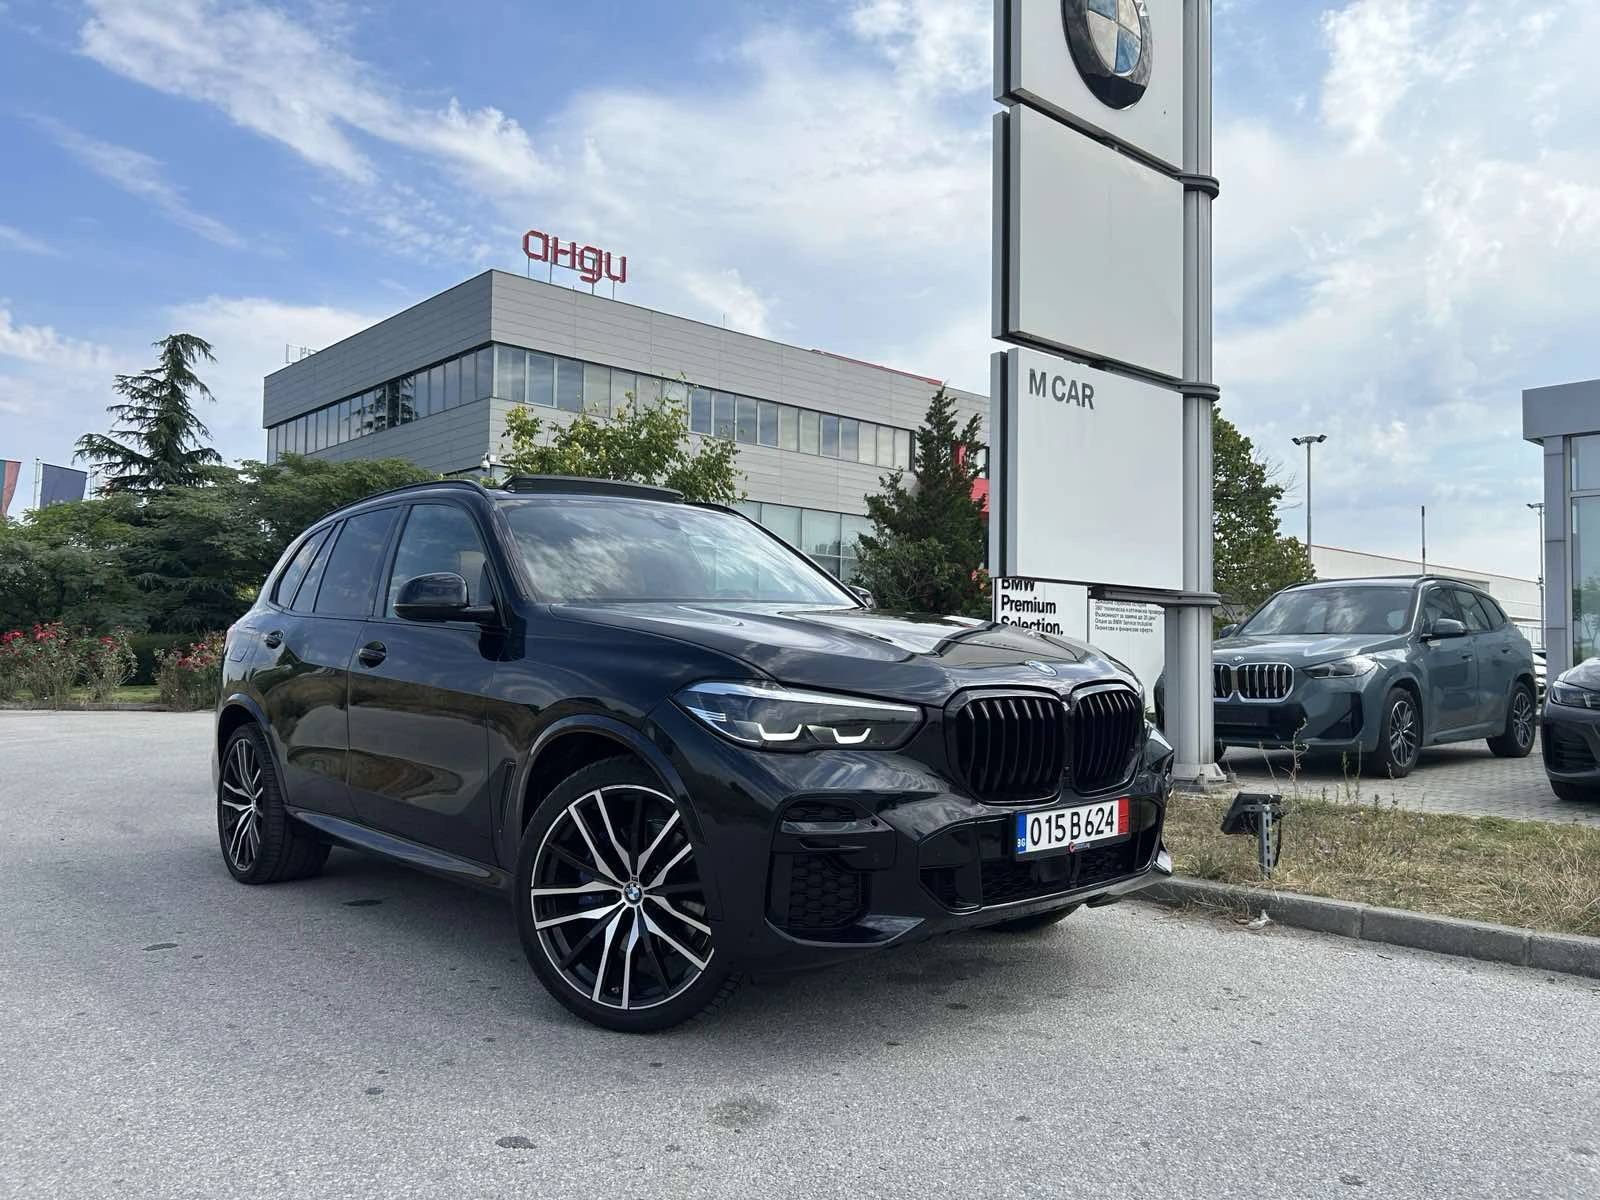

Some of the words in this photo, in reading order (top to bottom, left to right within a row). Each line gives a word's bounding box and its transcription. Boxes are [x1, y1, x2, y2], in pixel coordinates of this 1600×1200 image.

[1029, 368, 1046, 398] M
[1052, 375, 1094, 410] CAR
[1001, 579, 1035, 592] BMW
[1001, 594, 1056, 615] Premium
